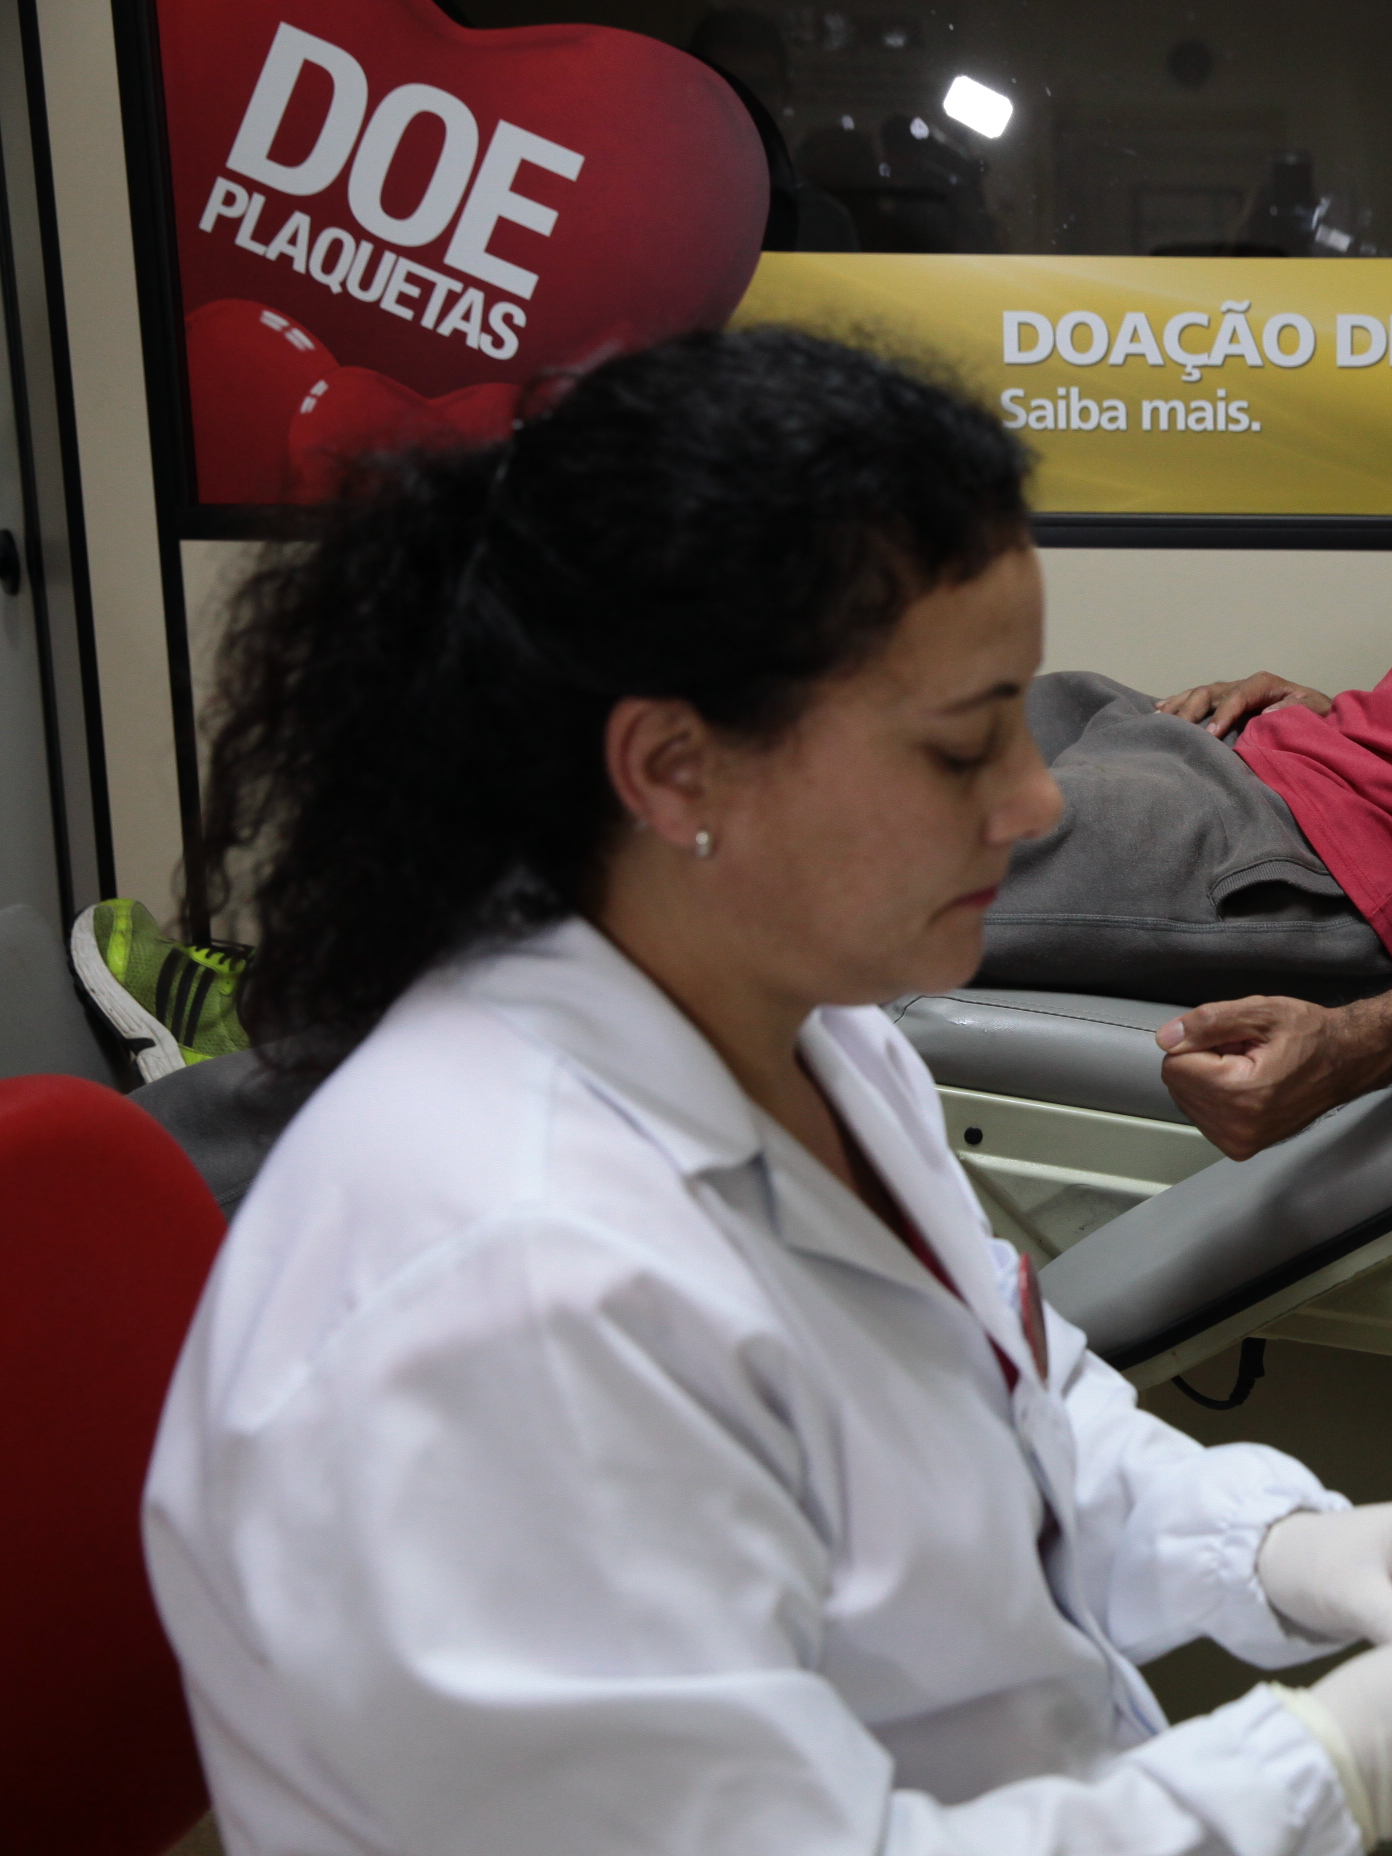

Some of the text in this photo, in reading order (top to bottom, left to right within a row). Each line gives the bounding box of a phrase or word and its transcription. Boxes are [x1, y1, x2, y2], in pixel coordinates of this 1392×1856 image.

[225, 21, 586, 300] DOE
[199, 176, 527, 361] PLAQUETAS
[1002, 300, 1316, 382] DOAÇÃO
[1000, 386, 1262, 432] Saiba mais.
